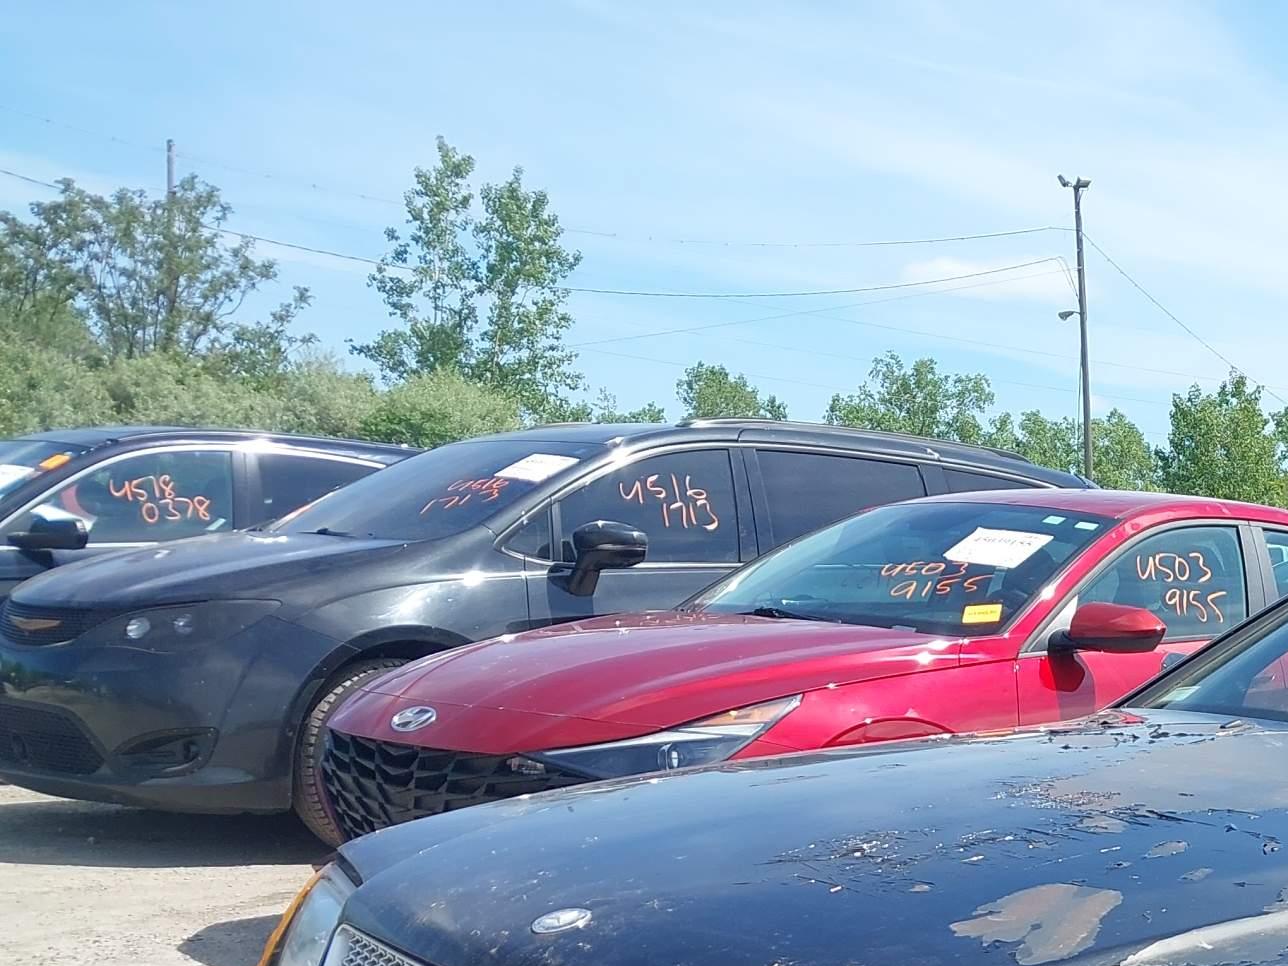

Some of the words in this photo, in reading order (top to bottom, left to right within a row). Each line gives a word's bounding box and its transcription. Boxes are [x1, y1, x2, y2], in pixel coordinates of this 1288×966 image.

[619, 473, 707, 504] 4516
[142, 496, 210, 522] 0378
[662, 499, 719, 530] 1713
[880, 561, 969, 578] 4503
[1136, 552, 1212, 583] 4503
[889, 574, 995, 600] 9155
[1165, 588, 1227, 623] 9155
